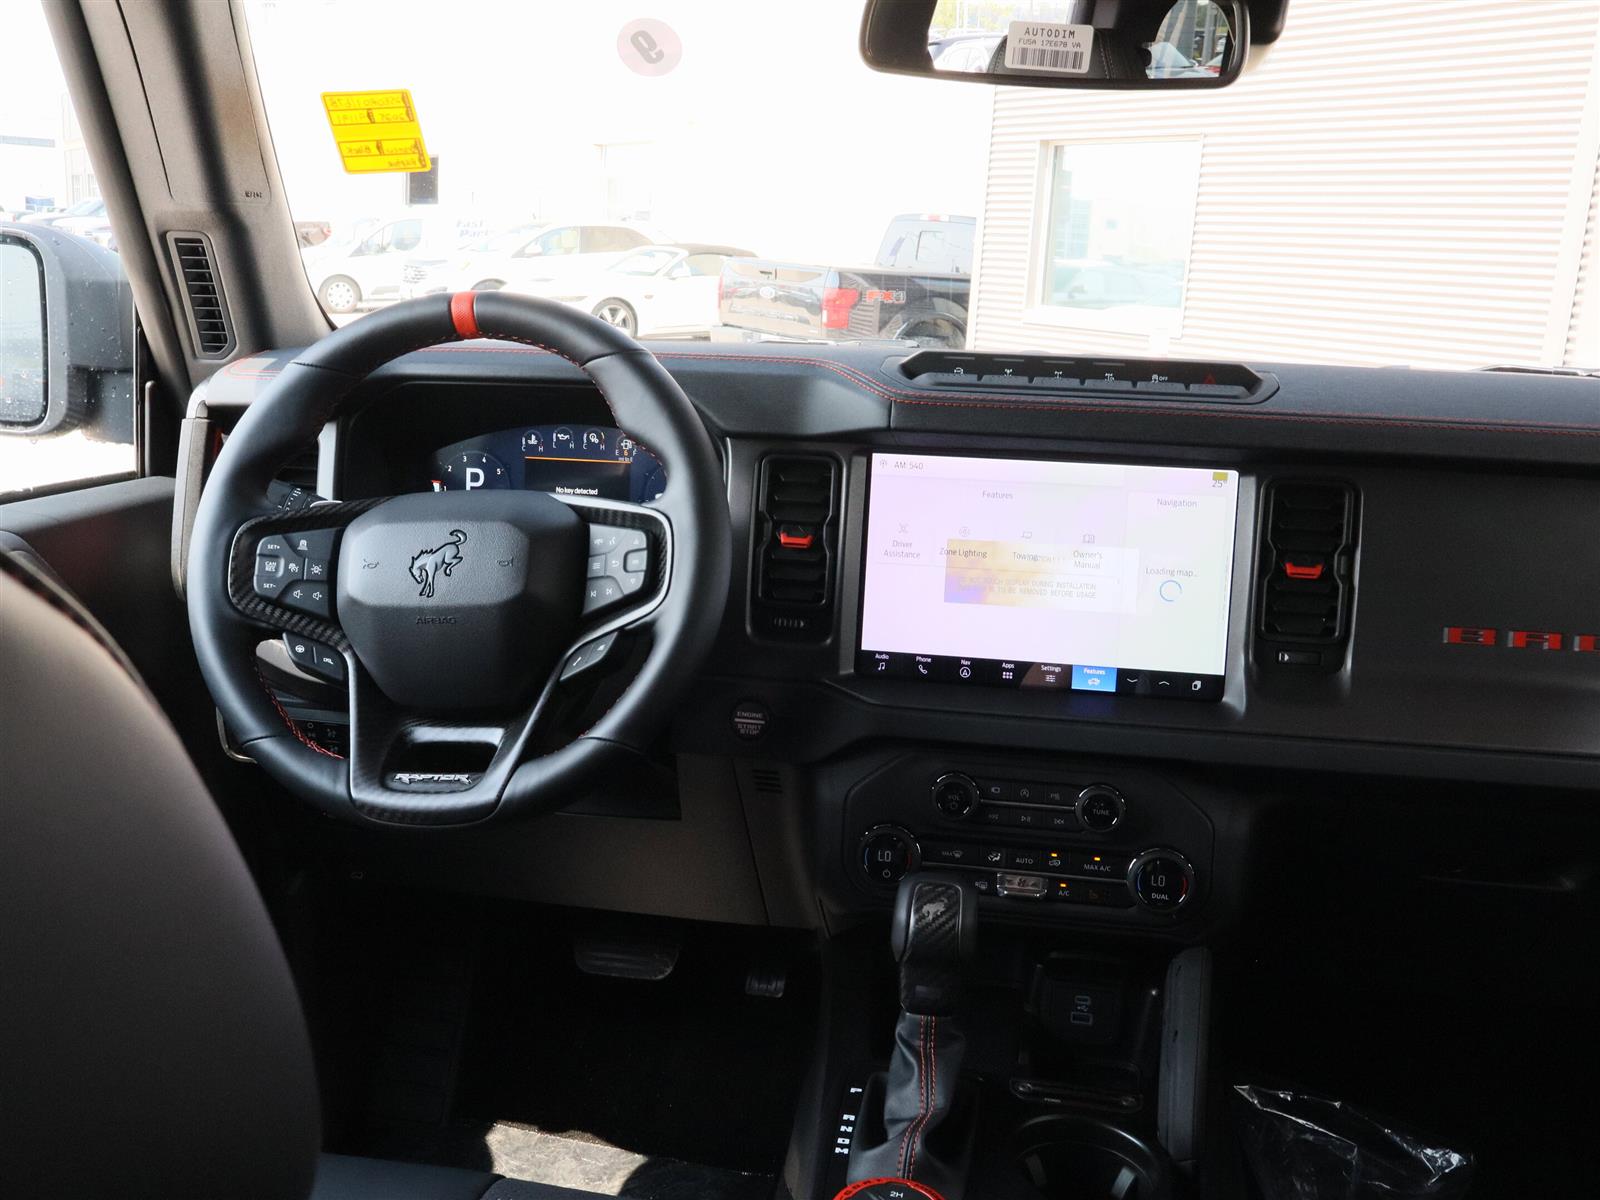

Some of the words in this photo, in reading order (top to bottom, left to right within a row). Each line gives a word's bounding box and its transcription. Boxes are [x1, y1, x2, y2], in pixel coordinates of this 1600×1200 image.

[1024, 27, 1076, 39] AUTODIM
[894, 461, 906, 469] AM
[909, 462, 924, 470] 540
[466, 468, 484, 490] P
[982, 490, 1014, 500] Features
[1156, 498, 1198, 508] Navigation
[892, 540, 913, 548] Driver
[884, 550, 920, 559] Assistance
[939, 548, 957, 556] Zone
[958, 548, 988, 558] Lighting
[1013, 552, 1038, 562] Towing
[1073, 550, 1104, 560] Owner's
[1073, 560, 1100, 569] Manual
[1145, 567, 1176, 576] Loading
[1056, 582, 1096, 590] INSTALLATION
[416, 615, 457, 624] AIRBAG
[1041, 664, 1062, 672] Settings
[394, 773, 472, 784] RAPTOR
[878, 850, 891, 862] LO
[1152, 875, 1165, 887] LO
